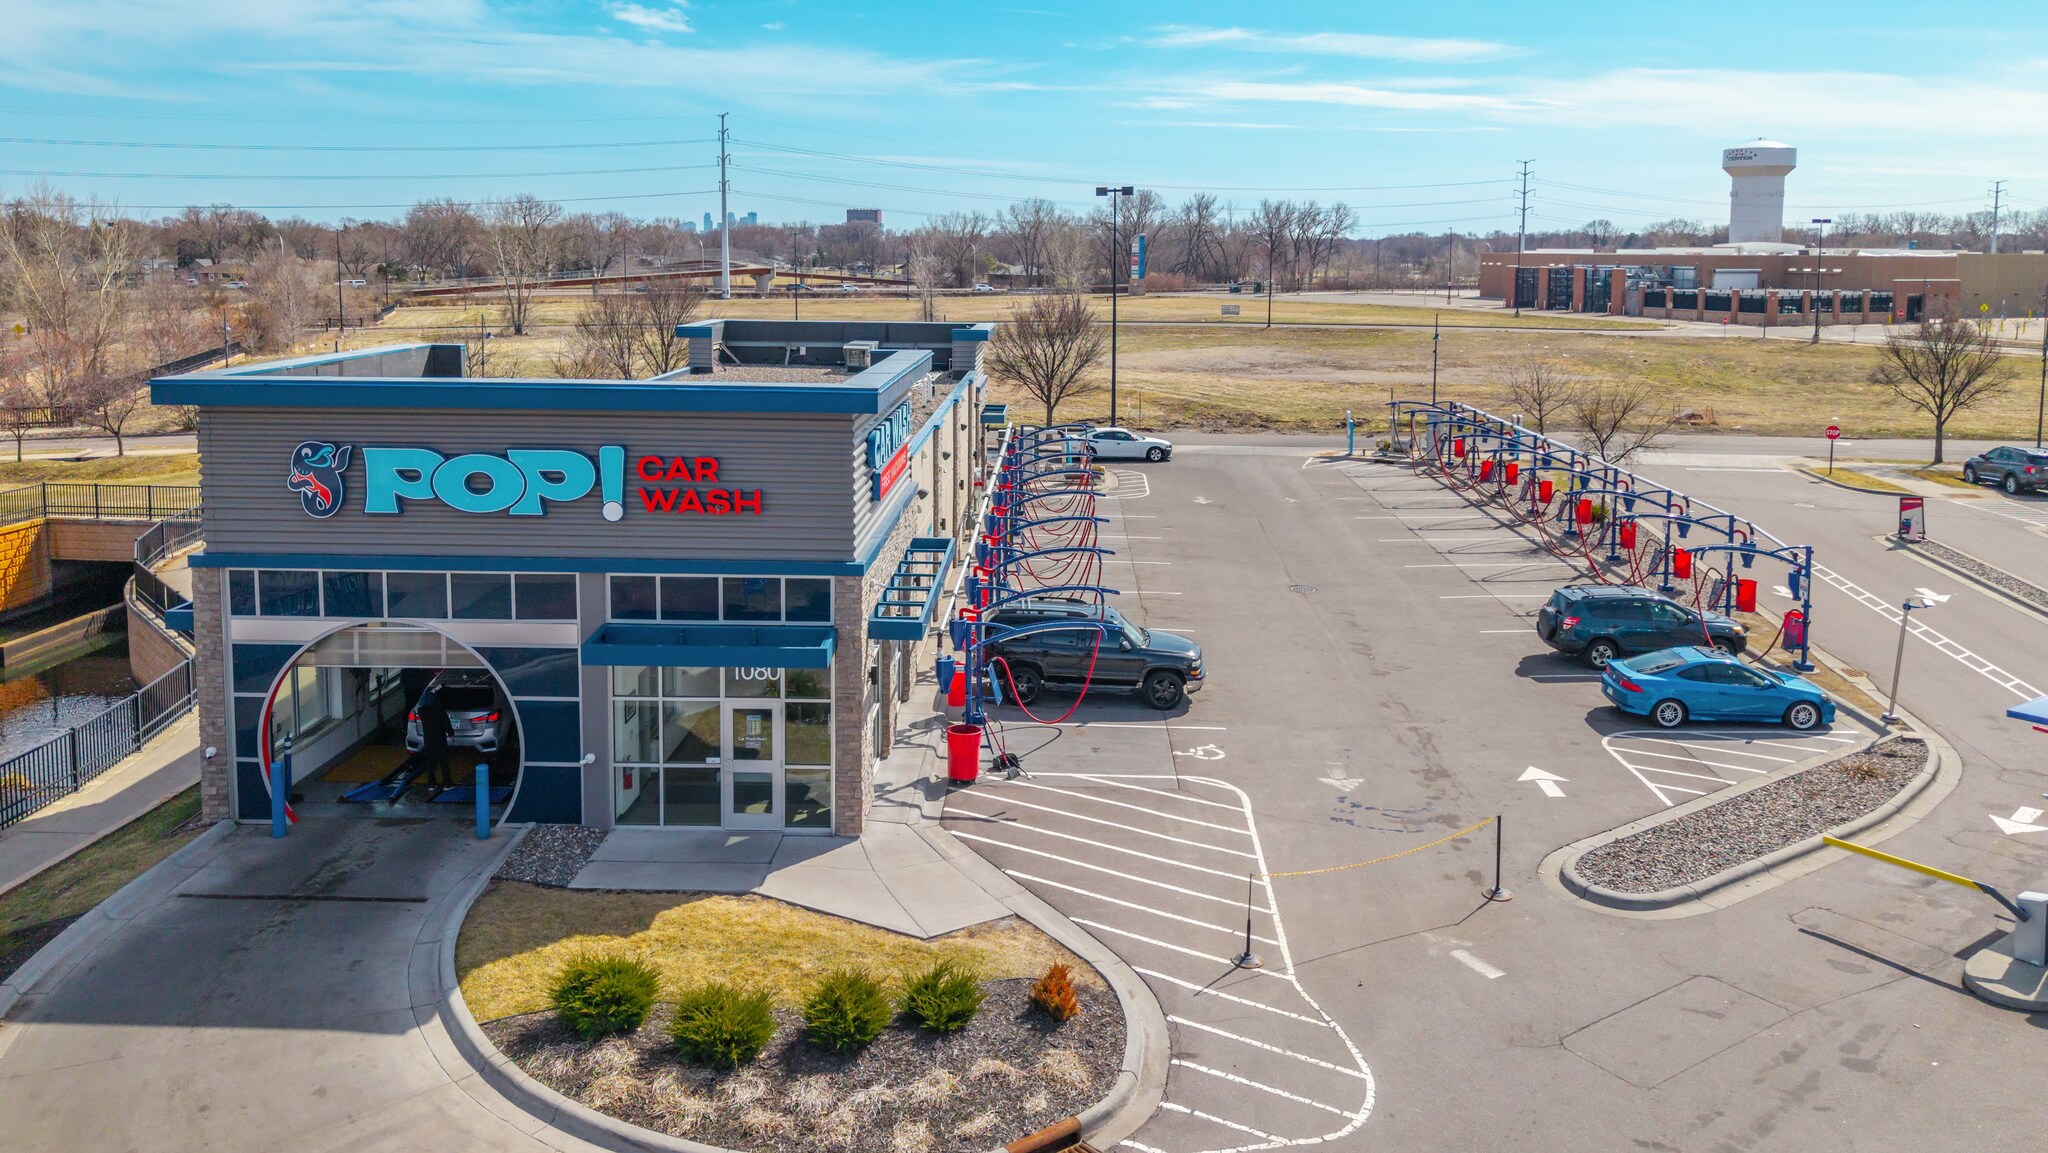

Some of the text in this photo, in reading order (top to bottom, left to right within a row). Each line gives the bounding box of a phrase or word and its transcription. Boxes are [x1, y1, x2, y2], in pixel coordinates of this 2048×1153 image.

[870, 401, 911, 469] CAR WASH
[361, 444, 627, 523] POP!
[637, 455, 720, 482] CAR
[638, 487, 762, 515] WASH
